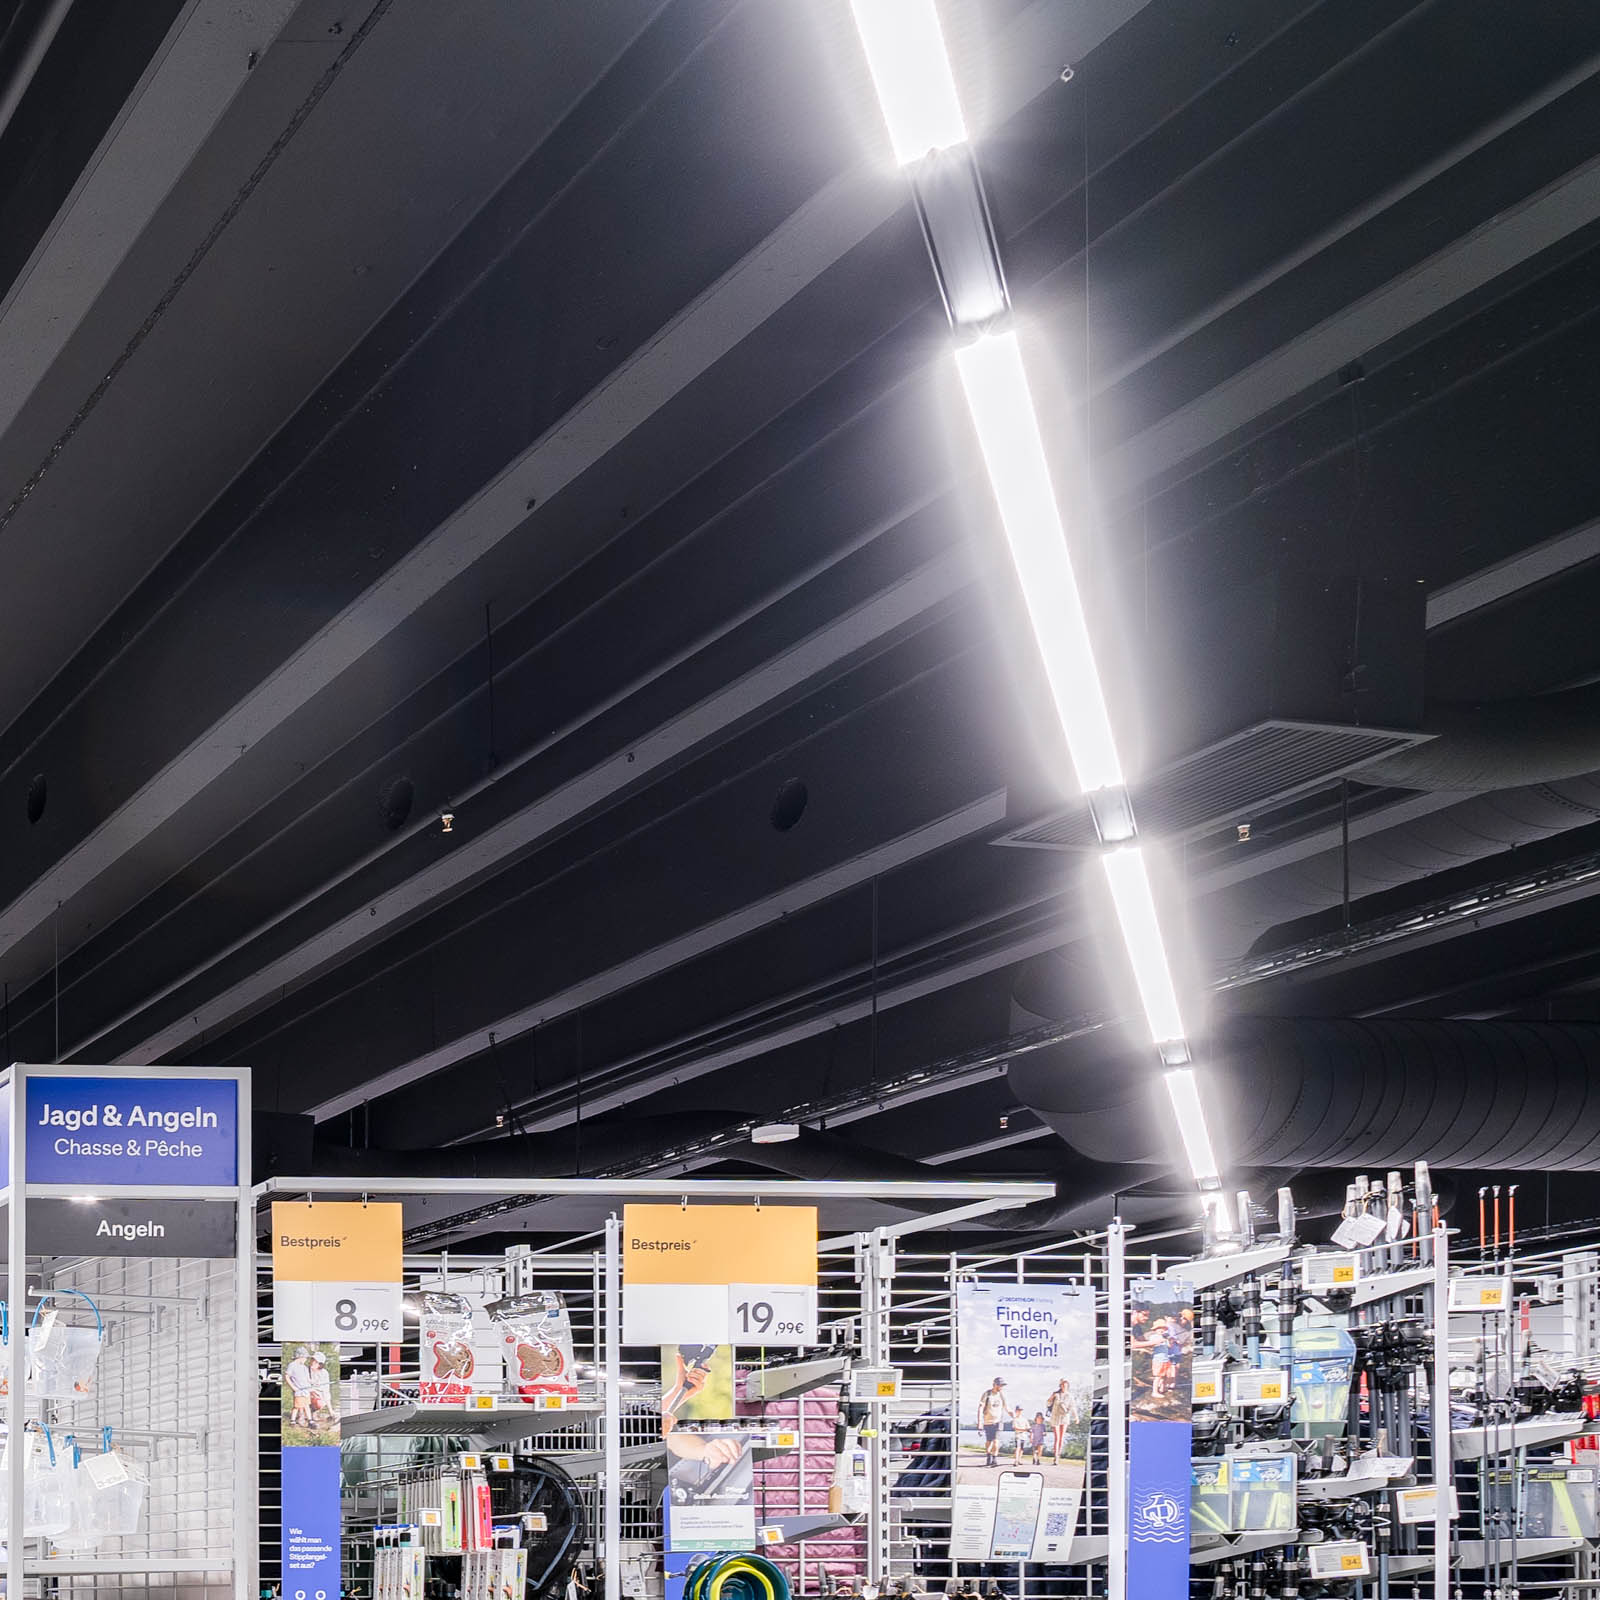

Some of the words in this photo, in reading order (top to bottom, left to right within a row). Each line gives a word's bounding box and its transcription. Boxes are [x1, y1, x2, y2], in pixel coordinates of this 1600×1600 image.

[39, 1104, 97, 1131] Jagd
[103, 1104, 122, 1127] &
[128, 1106, 218, 1132] Angeln
[54, 1138, 123, 1156] Chasse
[126, 1139, 141, 1156] &
[145, 1140, 203, 1157] Pêche
[96, 1220, 165, 1240] Angeln
[280, 1235, 341, 1249] Bestpreis
[631, 1238, 691, 1252] Bestpreis
[996, 1306, 1058, 1326] Finden,
[1000, 1324, 1054, 1343] Teilen,
[997, 1343, 1058, 1360] angeln!
